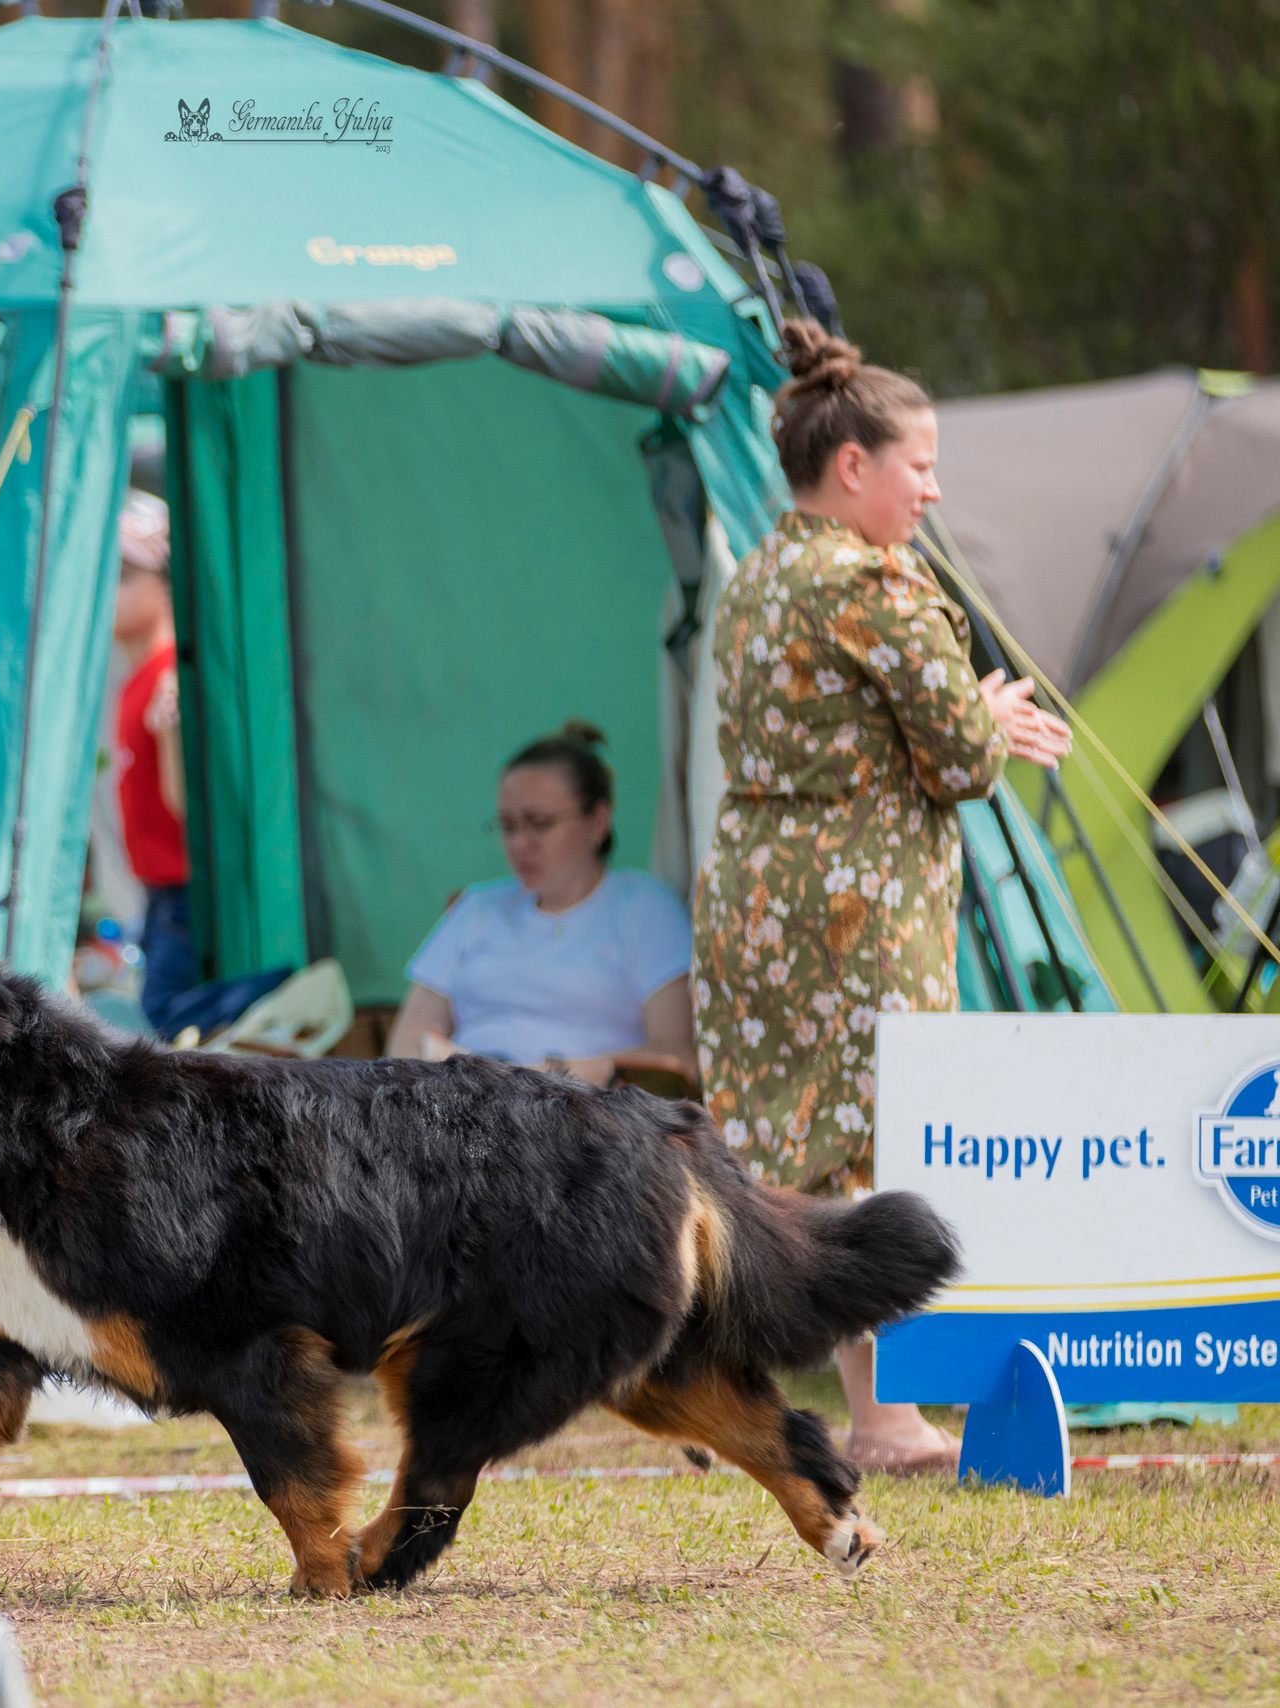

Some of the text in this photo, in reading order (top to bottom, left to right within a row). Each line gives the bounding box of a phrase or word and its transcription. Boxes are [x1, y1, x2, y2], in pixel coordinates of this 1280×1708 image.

[924, 1122, 1166, 1180] Happy pet.
[1213, 1125, 1280, 1168] Far
[1250, 1184, 1279, 1208] Pet
[1048, 1330, 1182, 1368] Nutrition
